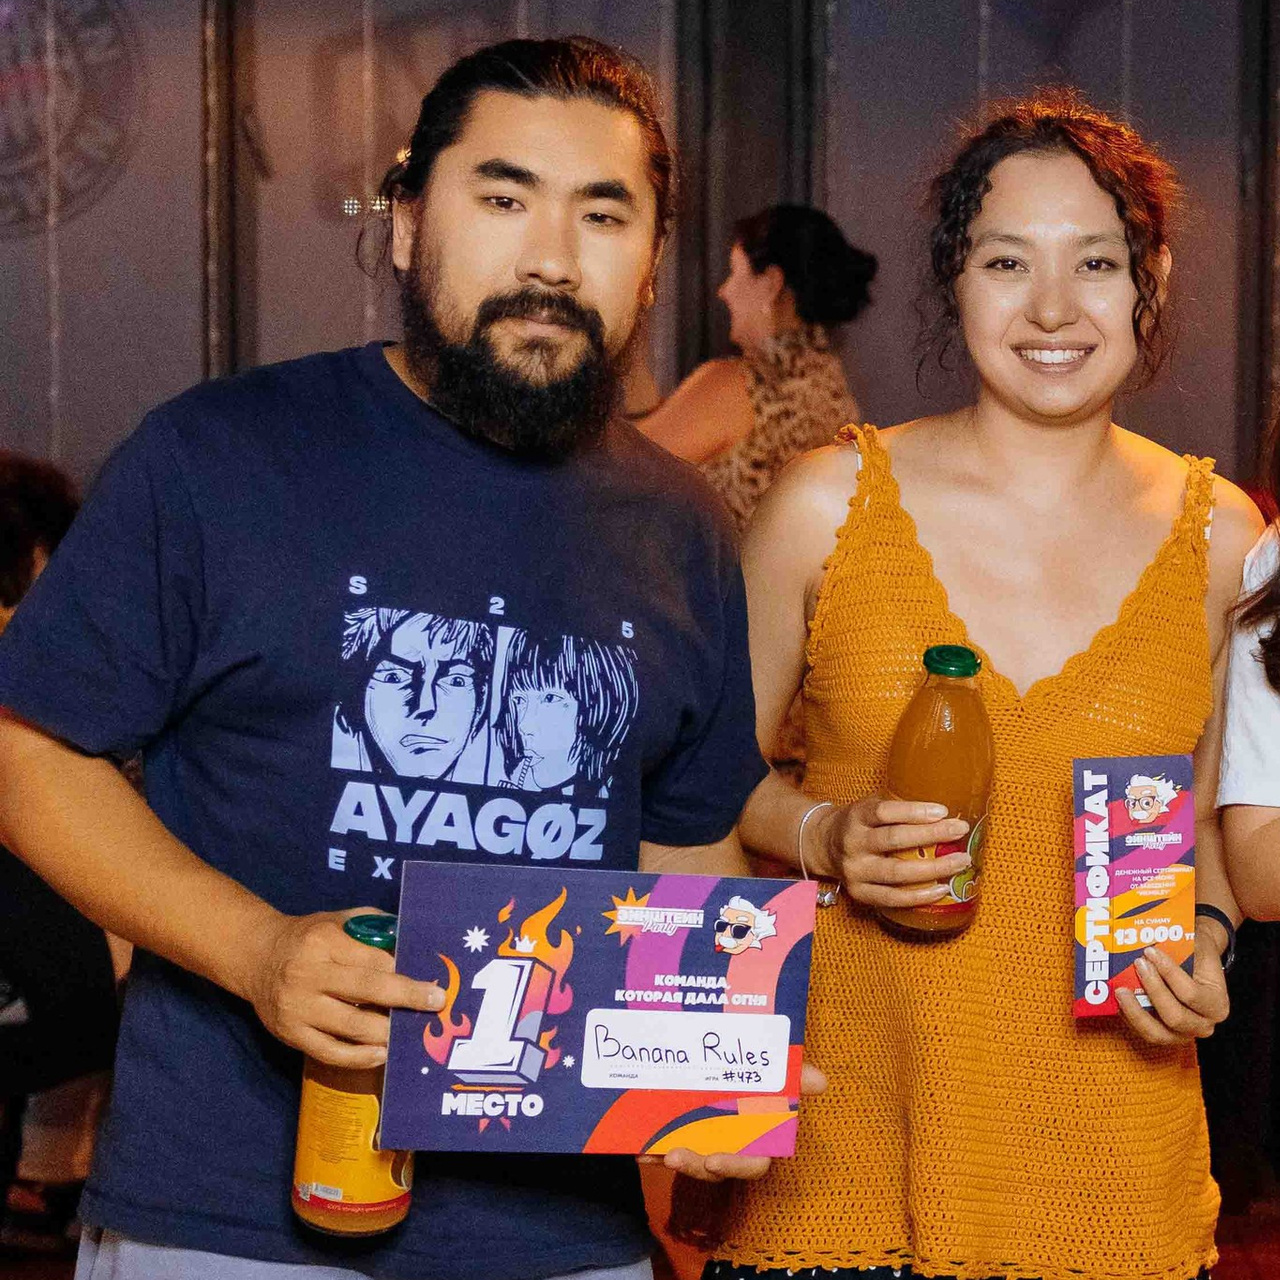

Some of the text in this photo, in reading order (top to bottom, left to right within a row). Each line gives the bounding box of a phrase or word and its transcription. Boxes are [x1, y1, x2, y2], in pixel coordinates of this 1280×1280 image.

[1083, 770, 1110, 1006] СЕРТИФИКАТ
[641, 920, 679, 936] Party
[1140, 924, 1183, 943] 000
[614, 989, 768, 1006] КОТОРАЯ ДАЛА ОГНЯ
[594, 1024, 770, 1066] Banana Rules
[722, 1070, 762, 1084] #473
[441, 1092, 544, 1117] МЕСТО
